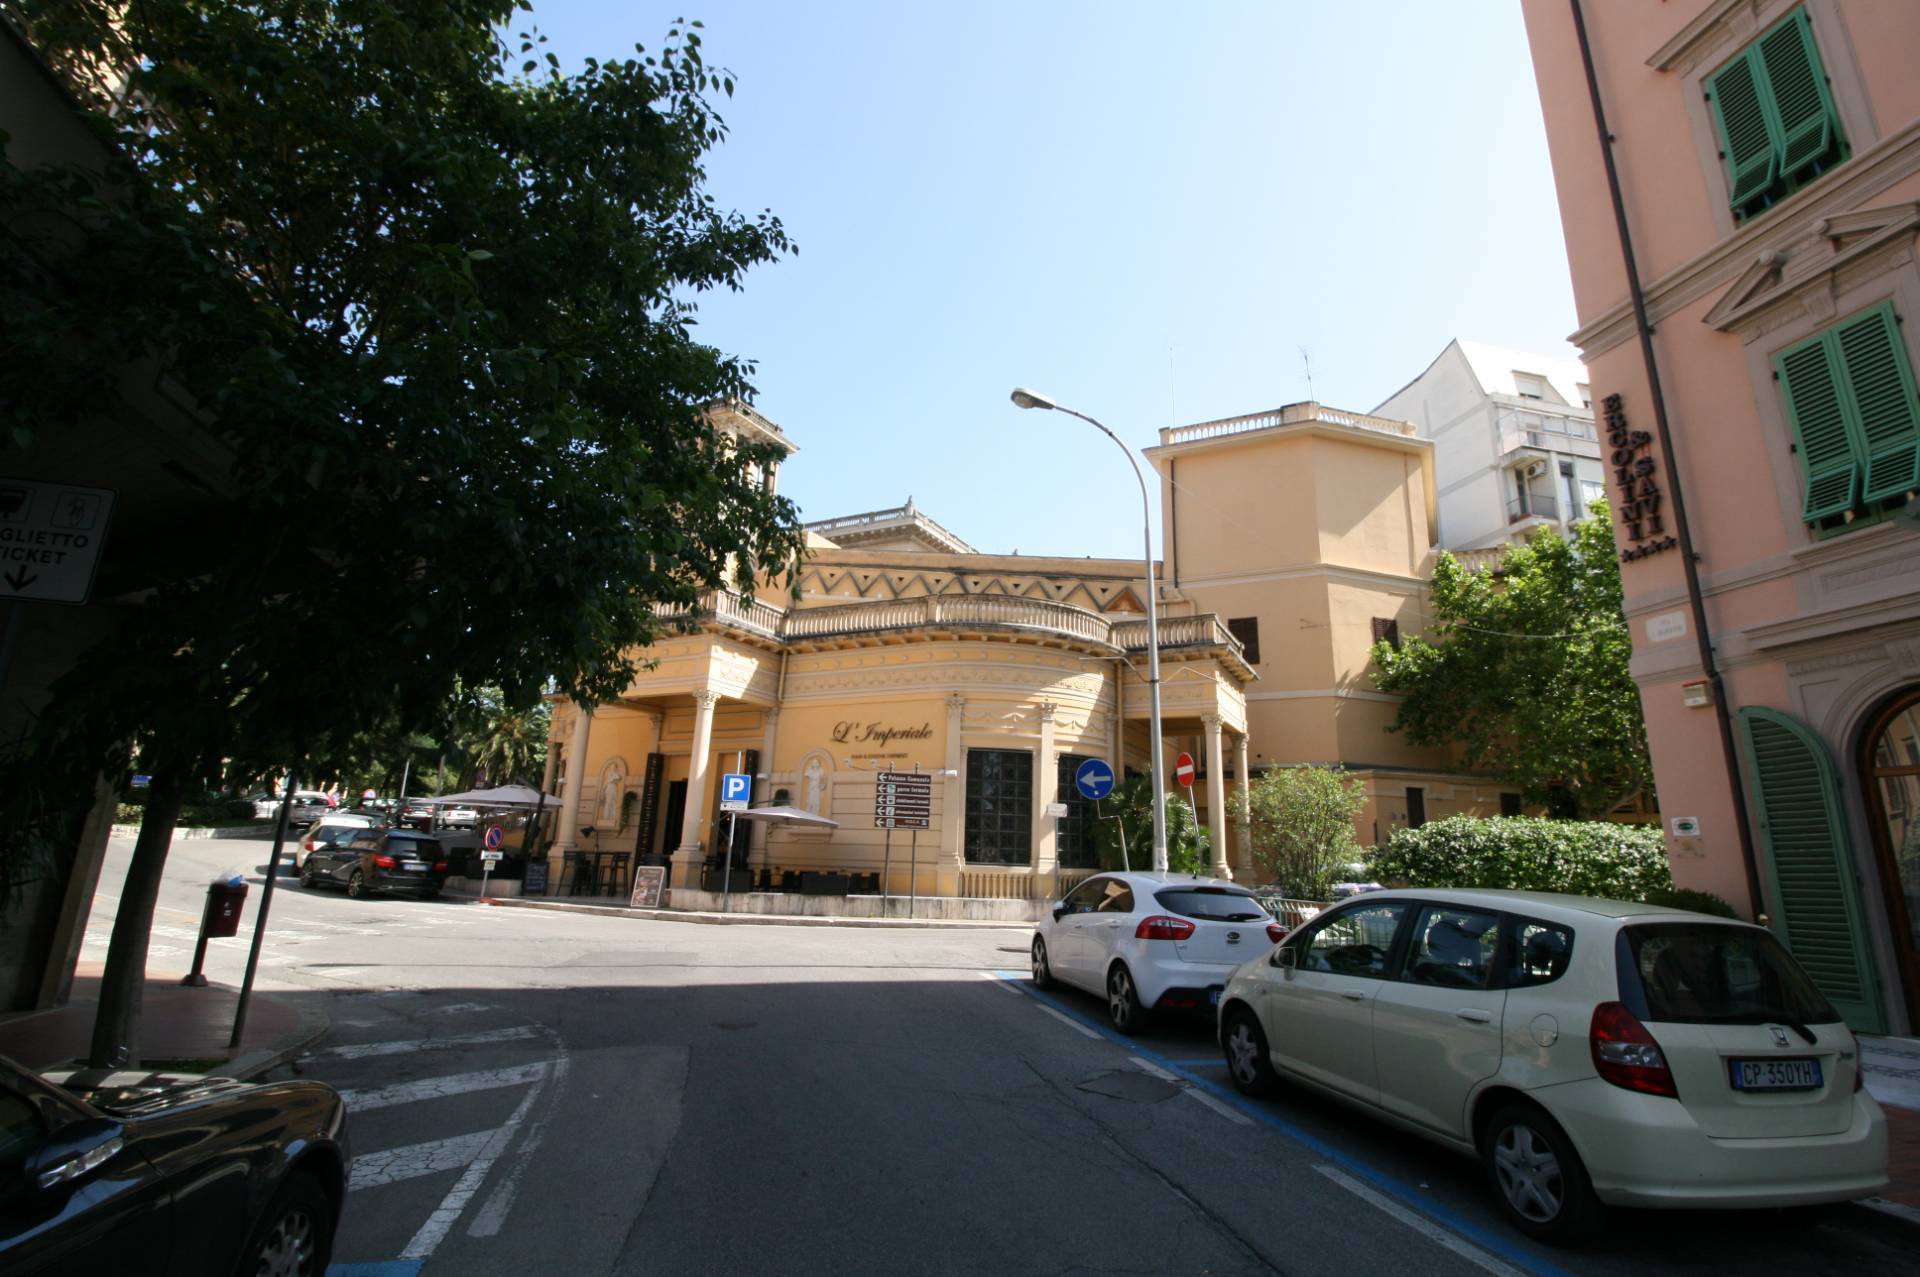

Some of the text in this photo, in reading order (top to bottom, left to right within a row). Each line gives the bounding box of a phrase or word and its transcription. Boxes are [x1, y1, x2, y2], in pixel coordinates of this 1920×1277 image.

[1601, 393, 1643, 541] ERCOLINI
[1630, 430, 1664, 534] & SAVI
[728, 777, 745, 798] P
[1743, 1064, 1812, 1085] CP 350YH
